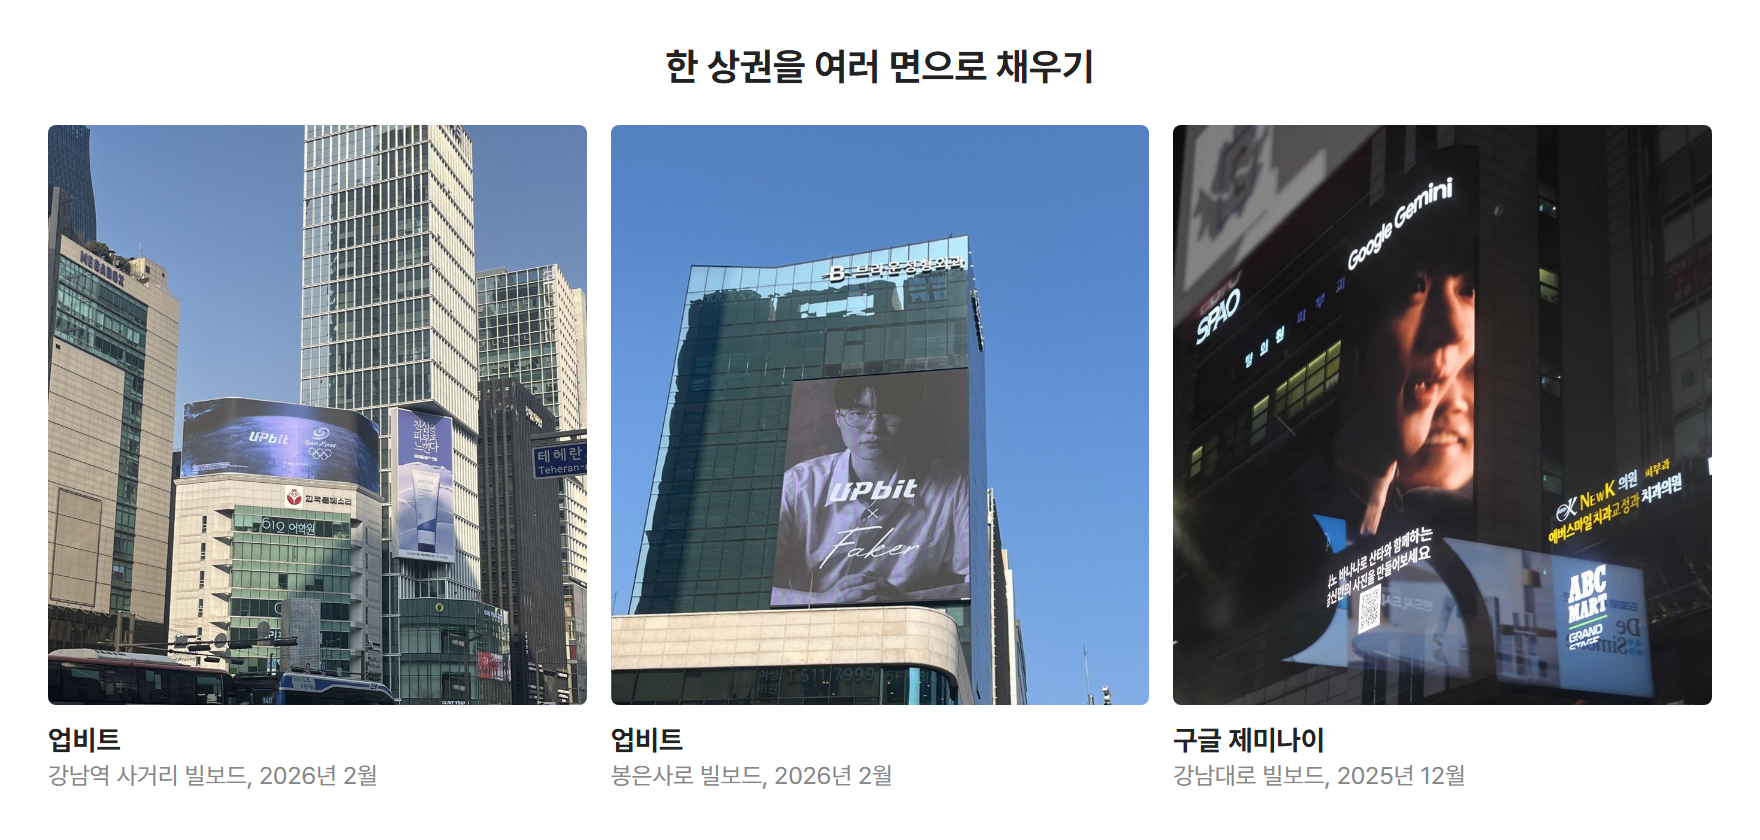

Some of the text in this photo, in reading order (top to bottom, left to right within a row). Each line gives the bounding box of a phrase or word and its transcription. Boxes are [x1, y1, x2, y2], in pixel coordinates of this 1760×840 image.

[1348, 177, 1453, 271] Google Gemini
[80, 250, 124, 288] MEGABOX
[855, 255, 965, 277] 브라운성형외과
[1195, 288, 1241, 345] SPAO
[537, 446, 587, 463] 테헤란
[1618, 469, 1638, 490] 의원
[1645, 458, 1671, 477] 피부과
[262, 517, 315, 536] 612 어학원
[1548, 513, 1592, 544] 에버스마일
[1641, 472, 1682, 503] 치과의원
[819, 525, 920, 569] Faker
[1338, 555, 1368, 581] 바나나로
[1369, 541, 1393, 567] 산타와
[1393, 526, 1433, 553] 함께하는
[1352, 569, 1376, 591] 사진을
[1376, 545, 1431, 580] 만들어보세요
[1568, 563, 1607, 604] ABC
[1568, 592, 1608, 624] MART
[1569, 623, 1603, 644] GRAND
